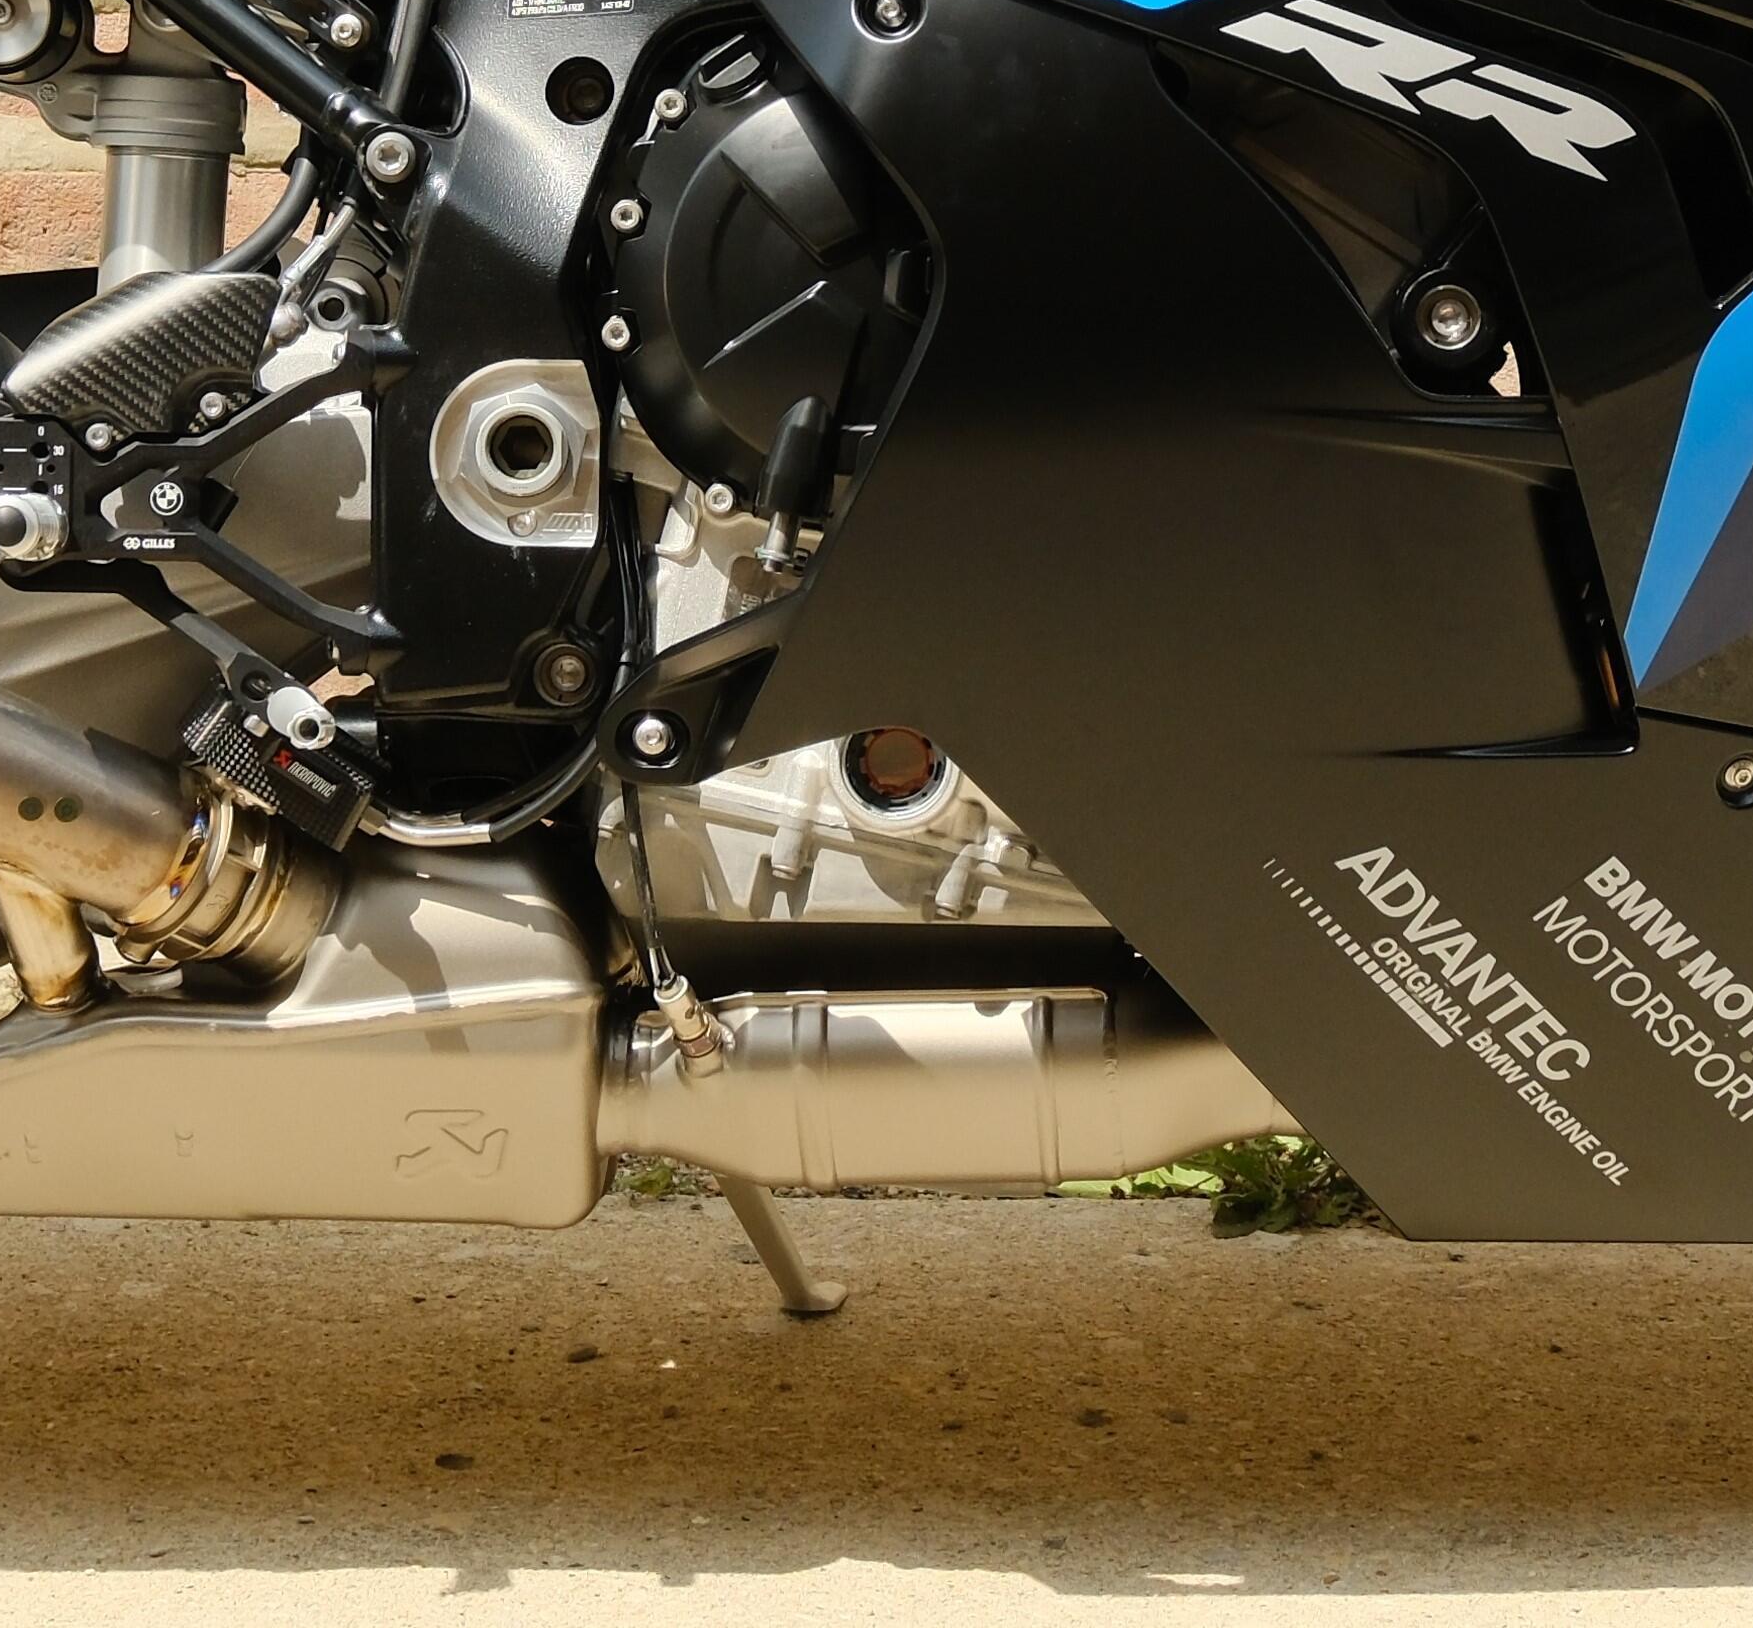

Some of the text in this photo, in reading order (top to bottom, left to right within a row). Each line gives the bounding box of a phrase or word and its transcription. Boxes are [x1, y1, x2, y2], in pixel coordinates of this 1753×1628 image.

[53, 446, 64, 456] 30
[53, 484, 64, 495] 15
[142, 538, 175, 549] GILLES
[1583, 855, 1700, 960] BMW
[1334, 846, 1590, 1081] ADVANTEC
[1372, 936, 1630, 1186] ORIGINAL BMW ENGINE OIL
